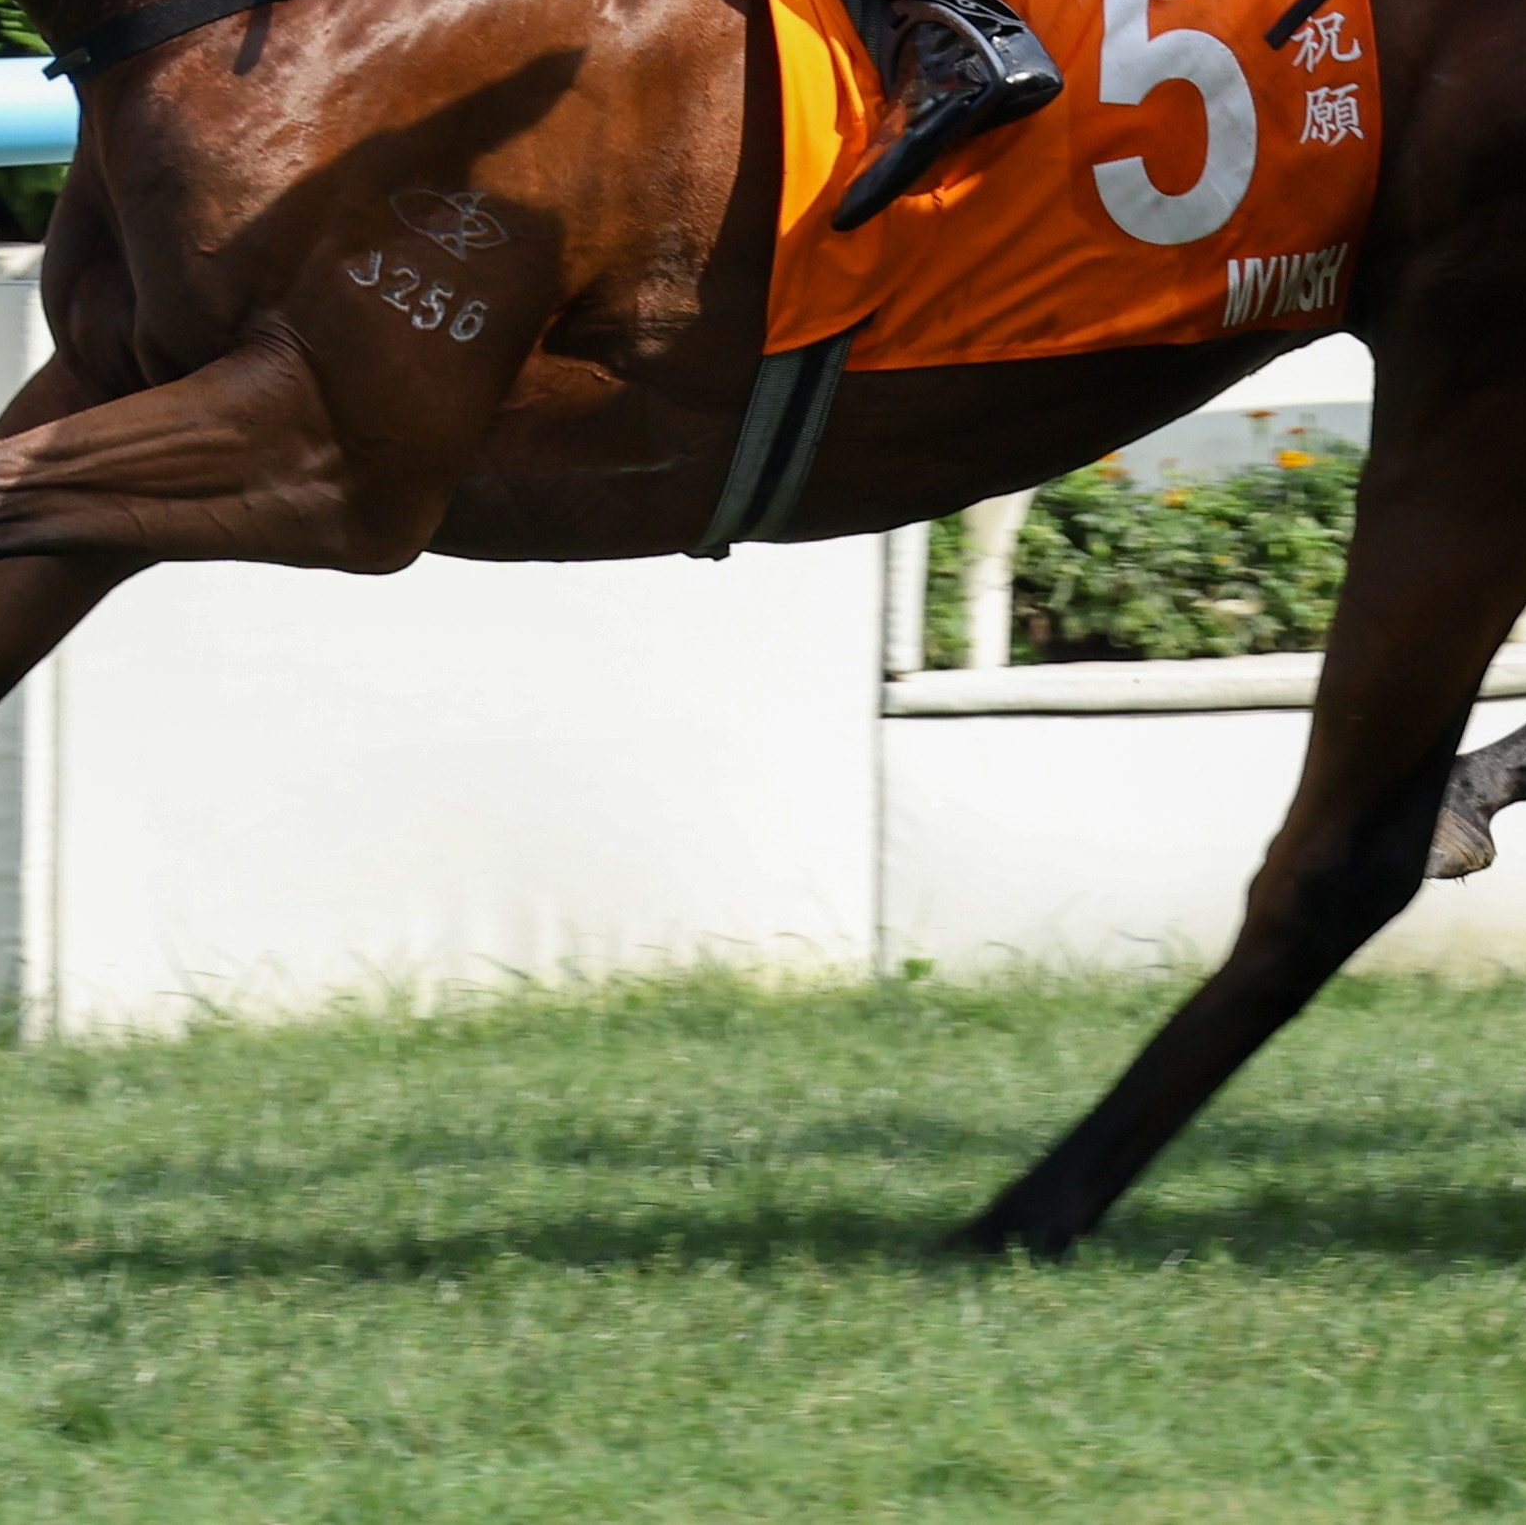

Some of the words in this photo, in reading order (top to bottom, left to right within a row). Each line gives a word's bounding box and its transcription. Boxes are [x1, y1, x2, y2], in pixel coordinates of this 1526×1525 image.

[1290, 11, 1365, 146] 祝願
[347, 250, 489, 342] J256
[1222, 256, 1278, 327] MY
